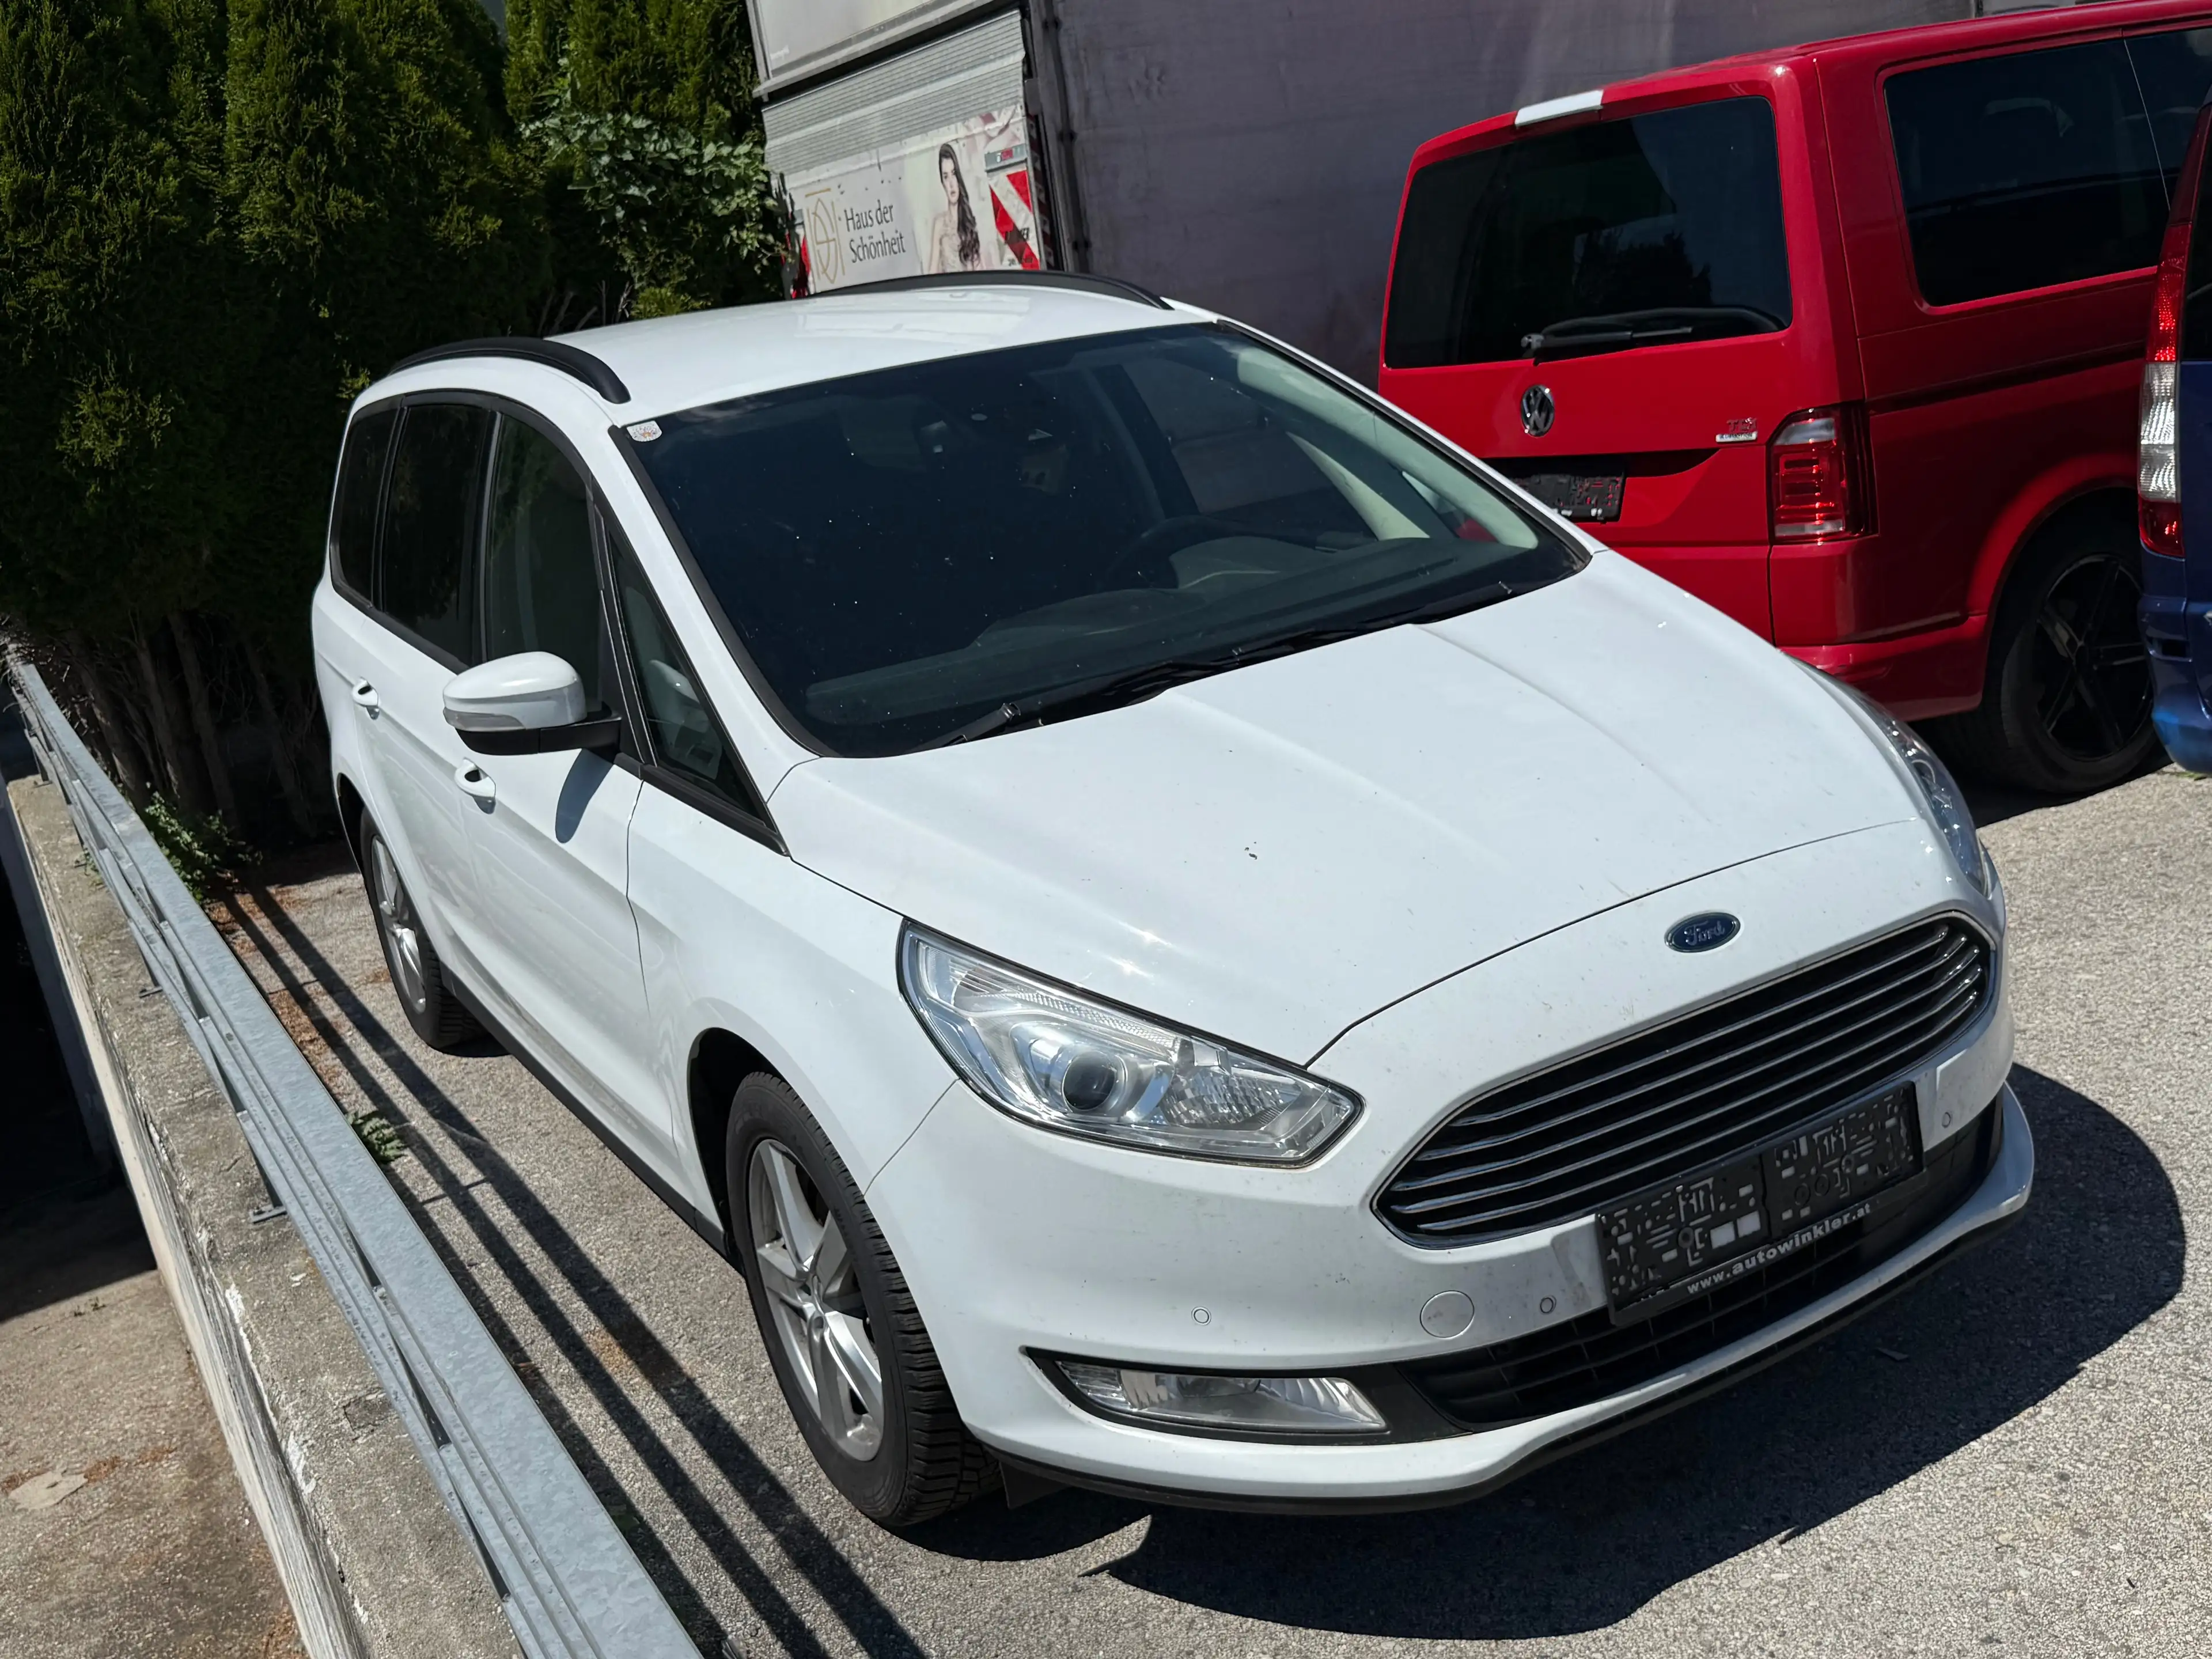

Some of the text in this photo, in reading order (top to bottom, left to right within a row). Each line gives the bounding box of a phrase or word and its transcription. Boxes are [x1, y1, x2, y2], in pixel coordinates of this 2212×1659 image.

[844, 199, 893, 232] Haus der
[849, 229, 906, 263] Schönheit
[1684, 921, 1725, 946] Ford
[1687, 1202, 1871, 1294] www.autowinkler.at
